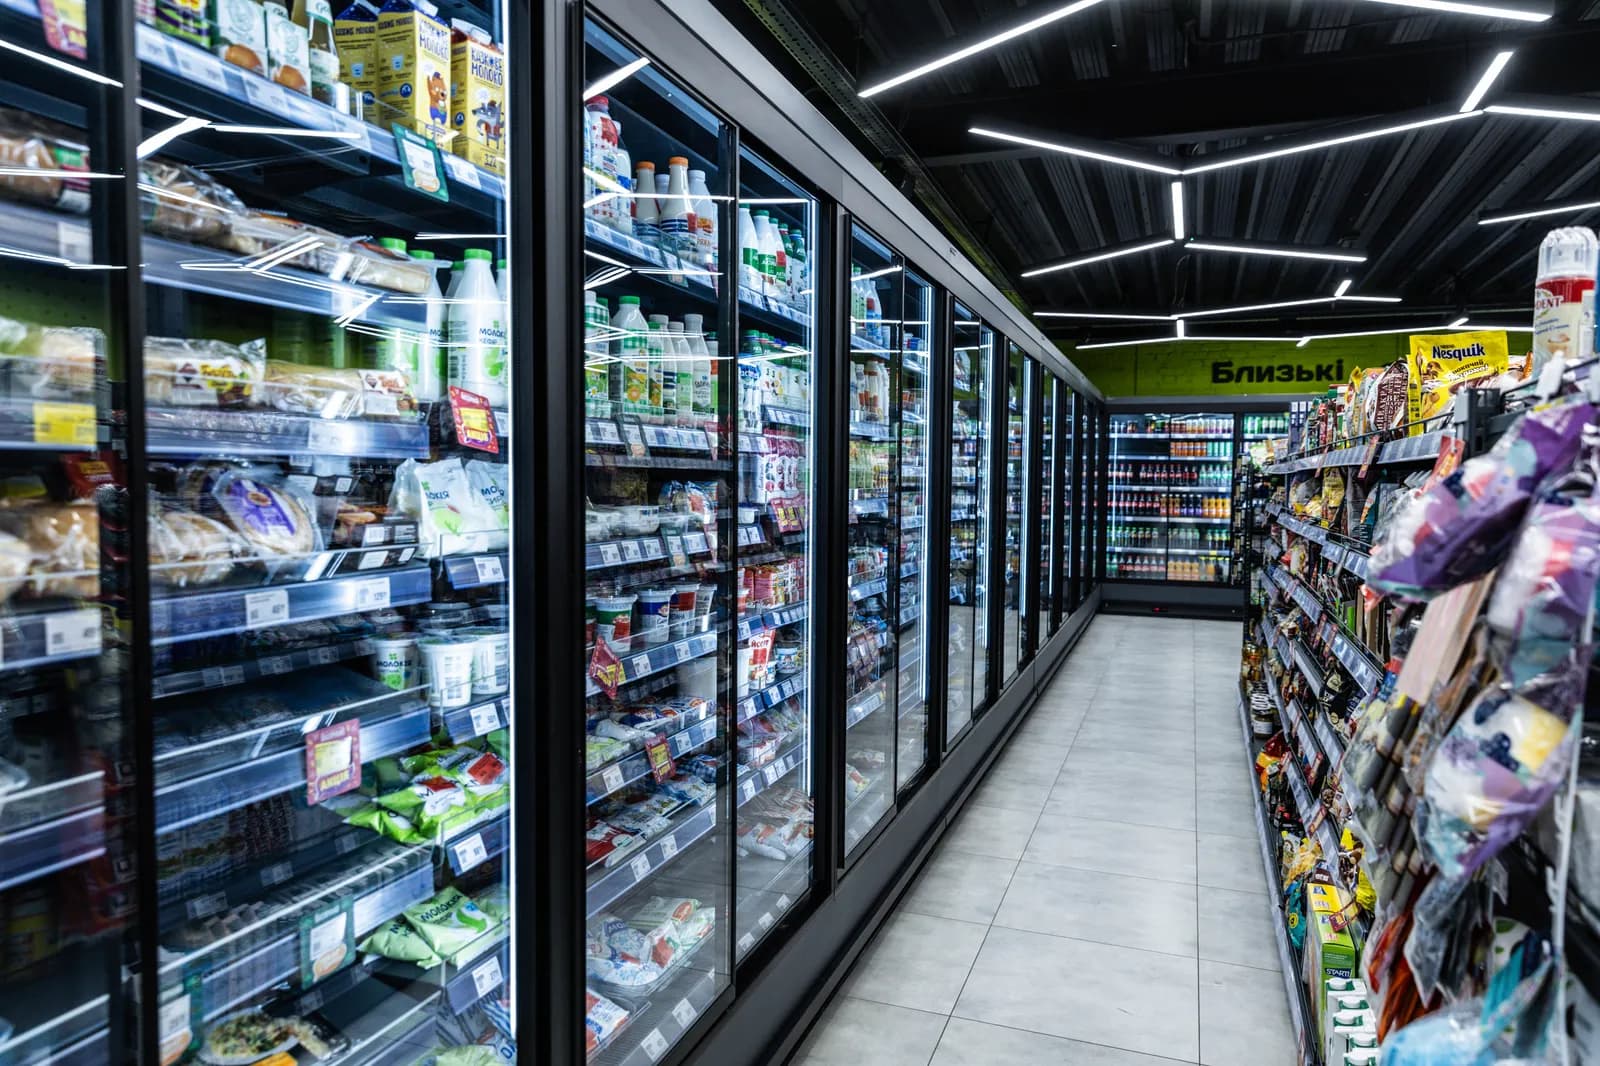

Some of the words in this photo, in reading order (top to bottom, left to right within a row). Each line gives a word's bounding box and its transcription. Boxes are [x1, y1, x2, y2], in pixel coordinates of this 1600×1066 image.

[471, 63, 503, 86] МОЛОКО
[1432, 343, 1485, 361] Nesquik
[1211, 359, 1344, 384] Близькі
